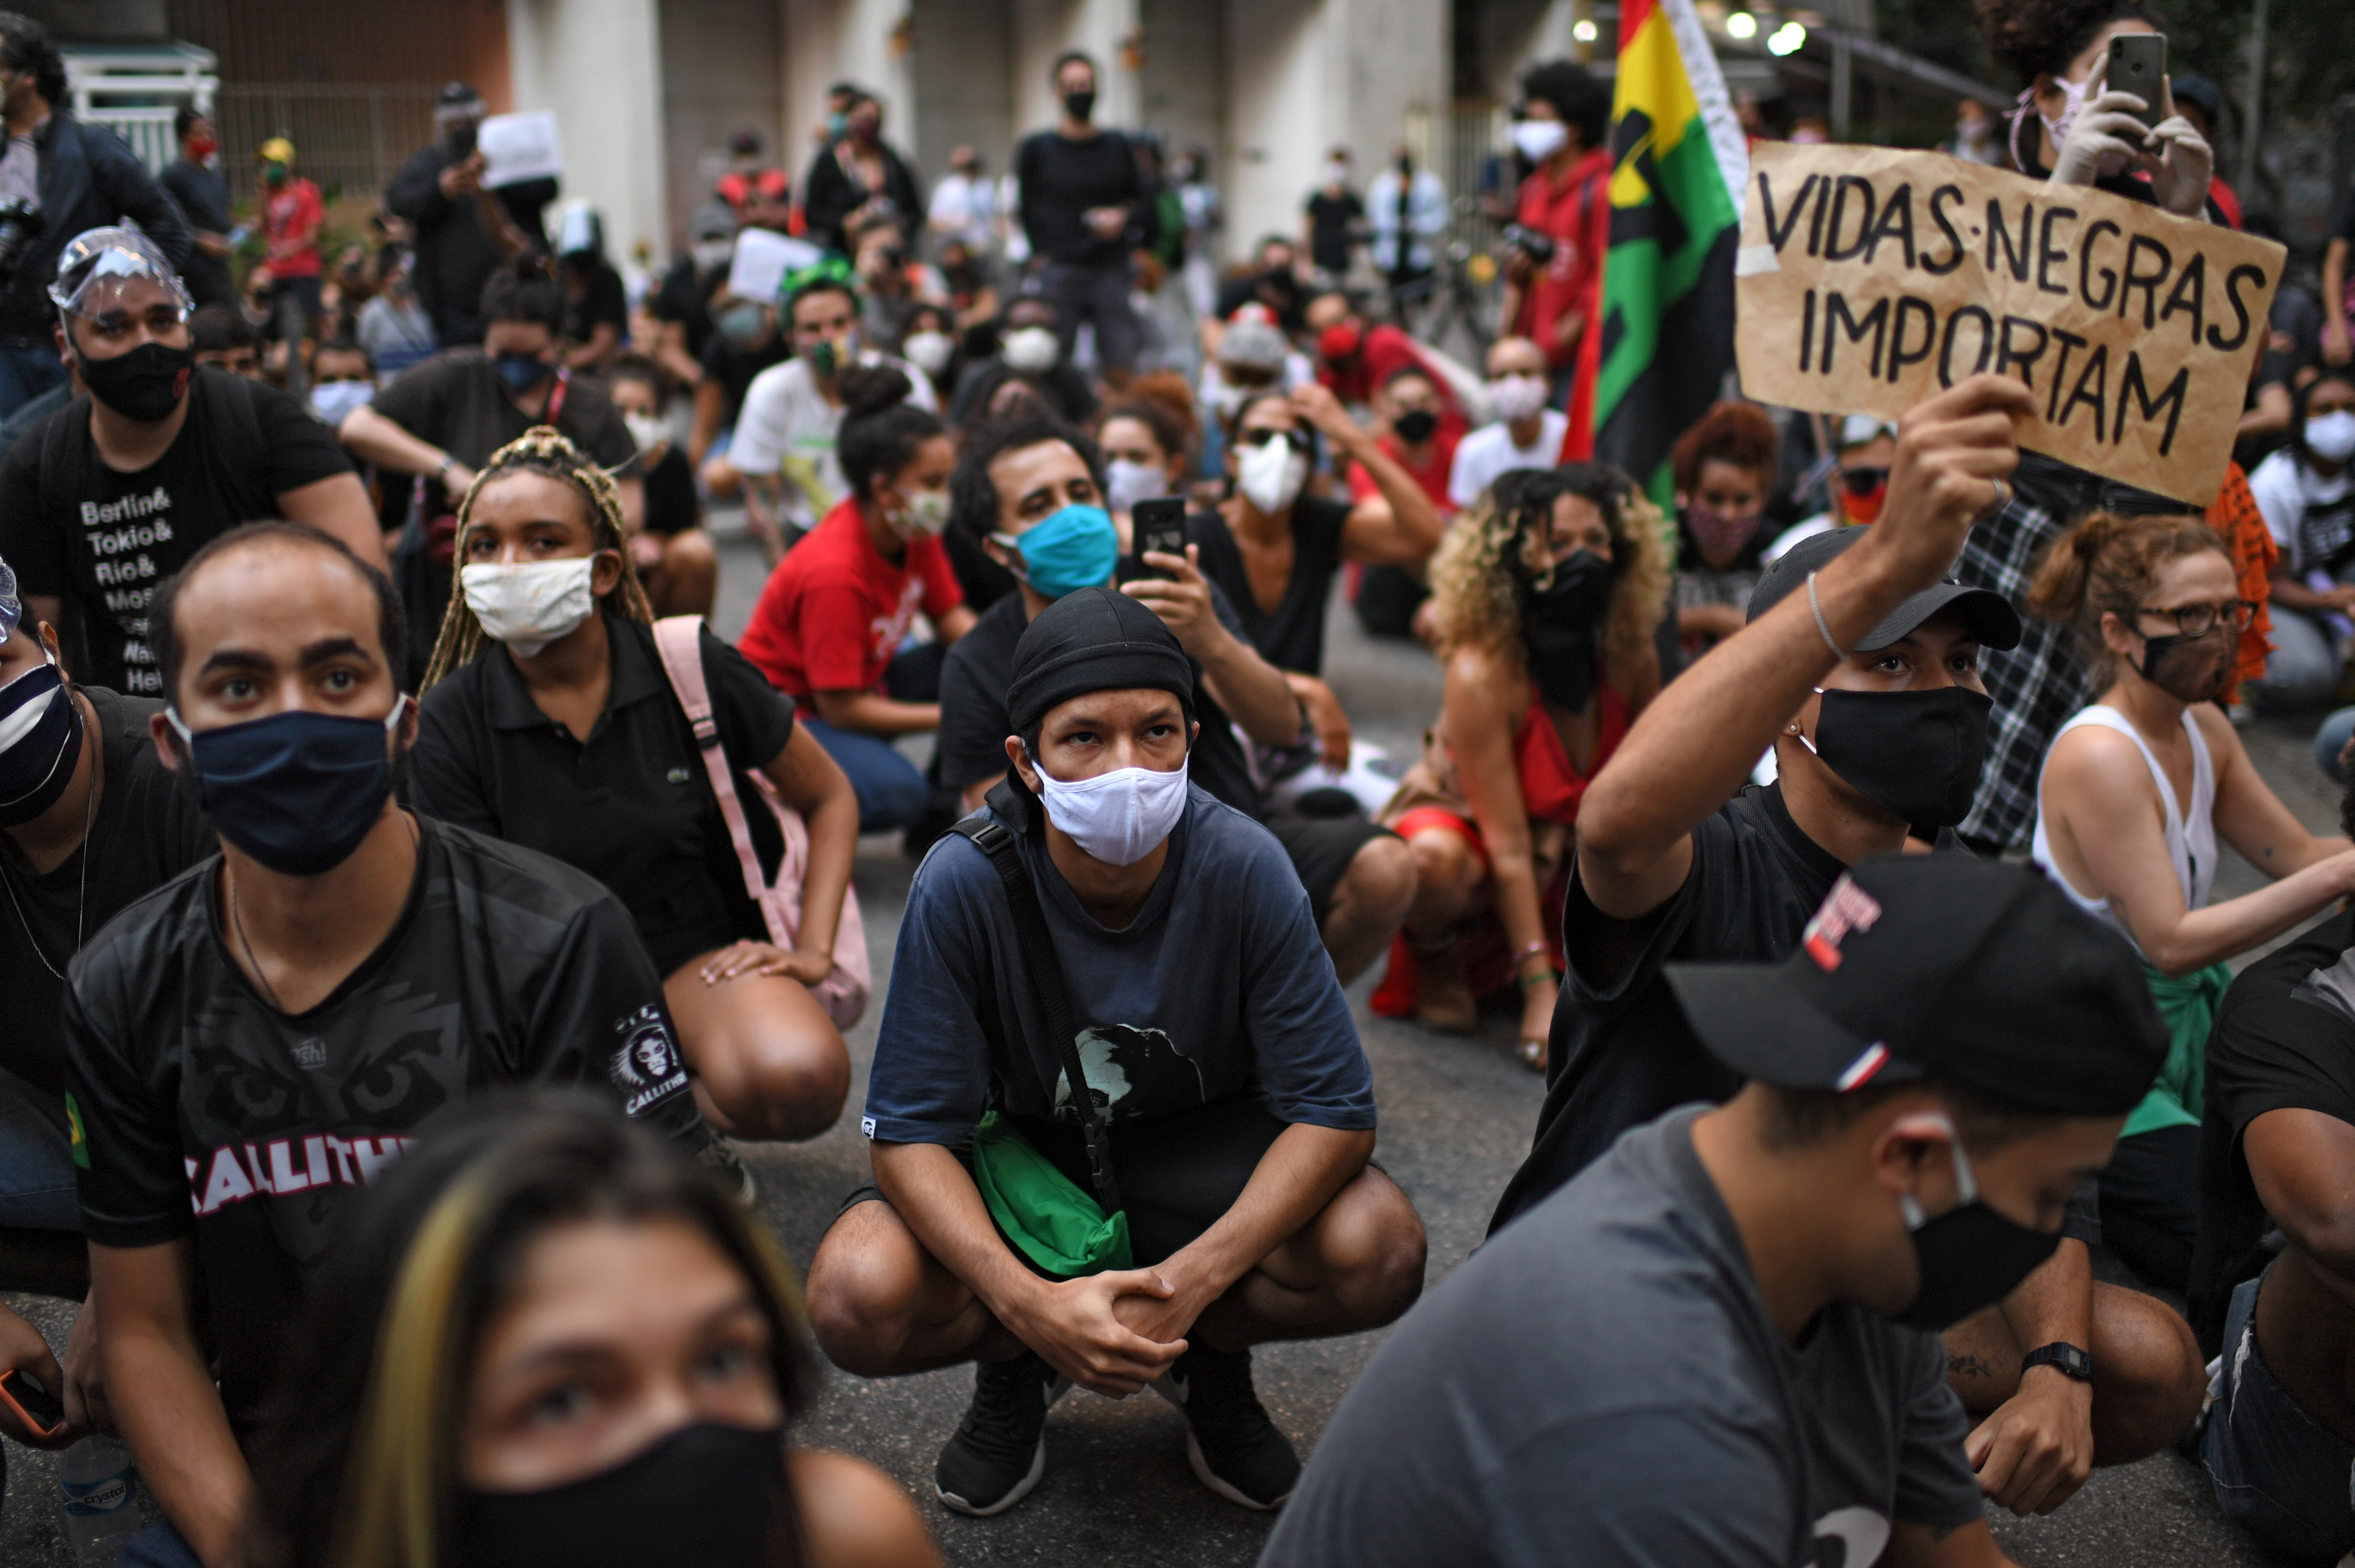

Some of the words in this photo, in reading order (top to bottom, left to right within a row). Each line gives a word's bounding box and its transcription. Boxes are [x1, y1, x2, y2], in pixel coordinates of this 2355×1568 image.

[1758, 171, 1964, 276] VIDAS
[1986, 197, 2266, 352] NEGRAS
[1799, 288, 2189, 457] IMPORTAM
[81, 486, 170, 525] Berlin&
[87, 517, 172, 556] Tokio&
[95, 554, 156, 586] Rio&
[105, 587, 153, 611] Mos
[184, 1135, 422, 1216] ALLITH
[84, 1483, 124, 1504] crystal
